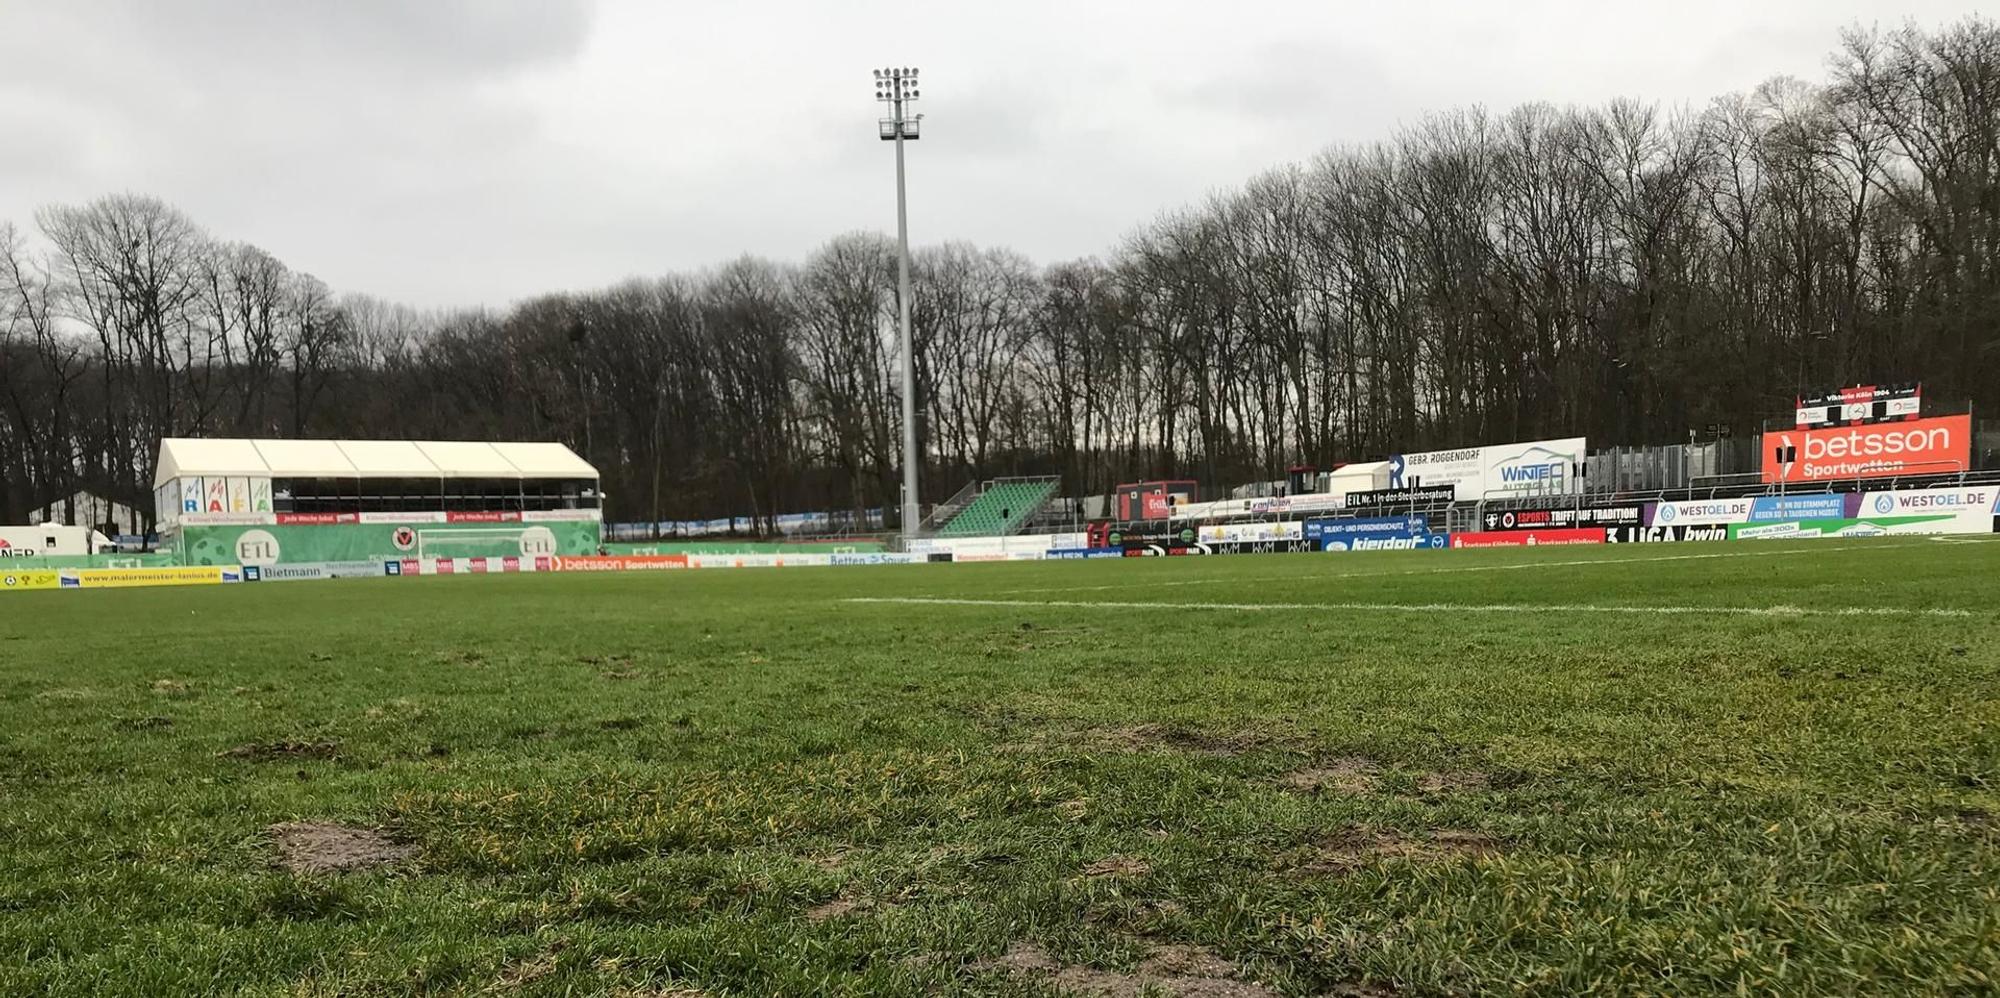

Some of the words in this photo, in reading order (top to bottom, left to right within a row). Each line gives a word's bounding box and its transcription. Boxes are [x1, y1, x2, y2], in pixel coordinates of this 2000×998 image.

[1826, 393, 1855, 402] Viktoria
[1803, 427, 1950, 459] betsson
[1408, 455, 1428, 466] GEBR.
[1430, 449, 1480, 463] ROGGENDORF
[1803, 458, 1904, 479] Sportwetten
[1361, 495, 1372, 504] Nr.
[1372, 494, 1377, 502] 1
[1398, 489, 1453, 502] Steuerberatung
[1899, 493, 1985, 507] WESTOEL.DE
[209, 500, 223, 512] A
[1680, 503, 1746, 516] WESTOEL.DE
[1518, 511, 1551, 523] ESPORTS
[1551, 510, 1576, 522] TRIFFT
[1592, 507, 1638, 519] TRADITION!
[1684, 524, 1727, 541] bwin
[241, 540, 275, 559] ETL
[1352, 536, 1426, 551] kierdorf
[565, 559, 623, 570] betsson
[830, 555, 865, 565] Betten
[264, 567, 320, 578] Bietmann
